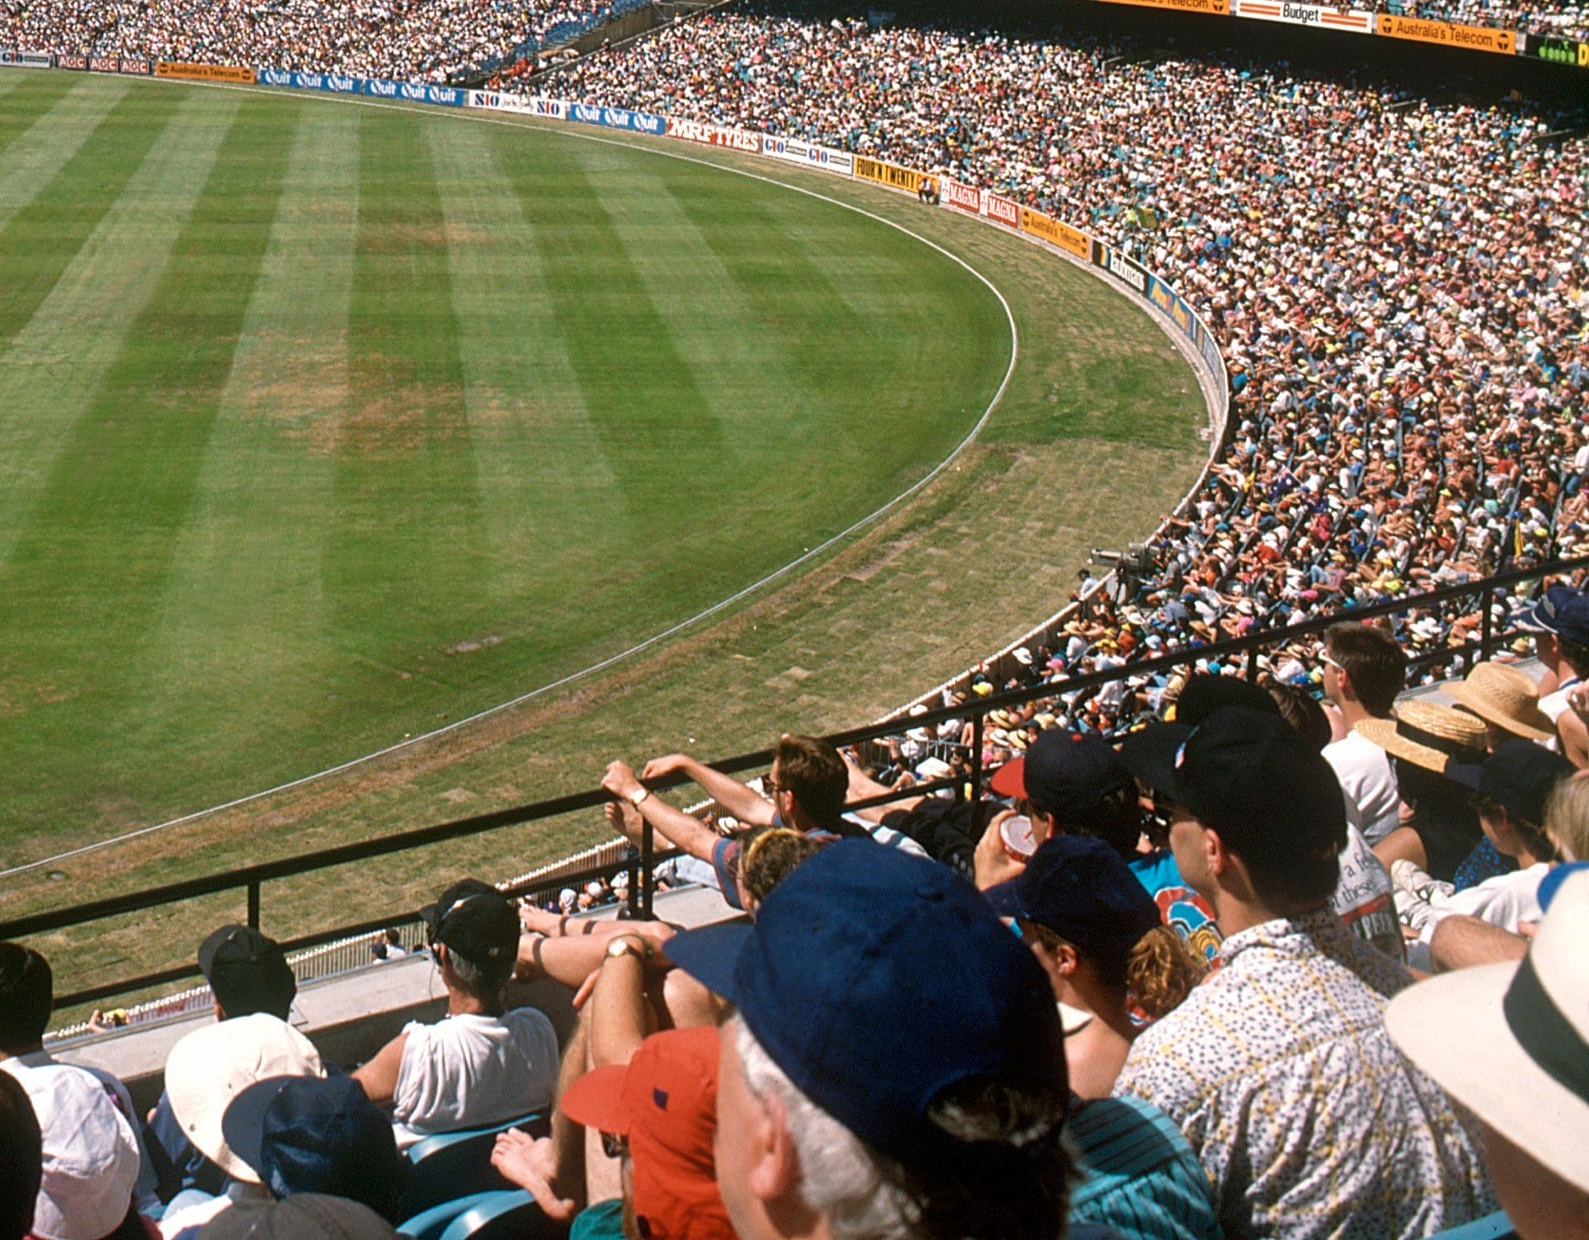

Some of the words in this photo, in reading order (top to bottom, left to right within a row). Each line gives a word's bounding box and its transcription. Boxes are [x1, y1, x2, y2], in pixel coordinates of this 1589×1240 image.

[1282, 4, 1319, 23] Budget
[1396, 21, 1446, 40] Australia's
[1449, 26, 1492, 46] Telecom
[169, 64, 208, 75] Australia's
[210, 68, 240, 78] Telecom
[265, 70, 291, 85] Quit
[296, 73, 322, 88] Quit
[328, 76, 353, 91] Quit
[370, 79, 395, 95] Quit
[401, 82, 426, 99] Quit
[429, 86, 457, 103] Quit
[575, 105, 600, 121] Quit
[604, 109, 629, 126] Quit
[633, 113, 658, 131] Quit
[668, 118, 712, 142] MRF
[716, 129, 759, 152] TYRES
[885, 164, 915, 189] TWENTY
[949, 182, 979, 208] MAGNA
[988, 195, 1016, 223] MAGNA
